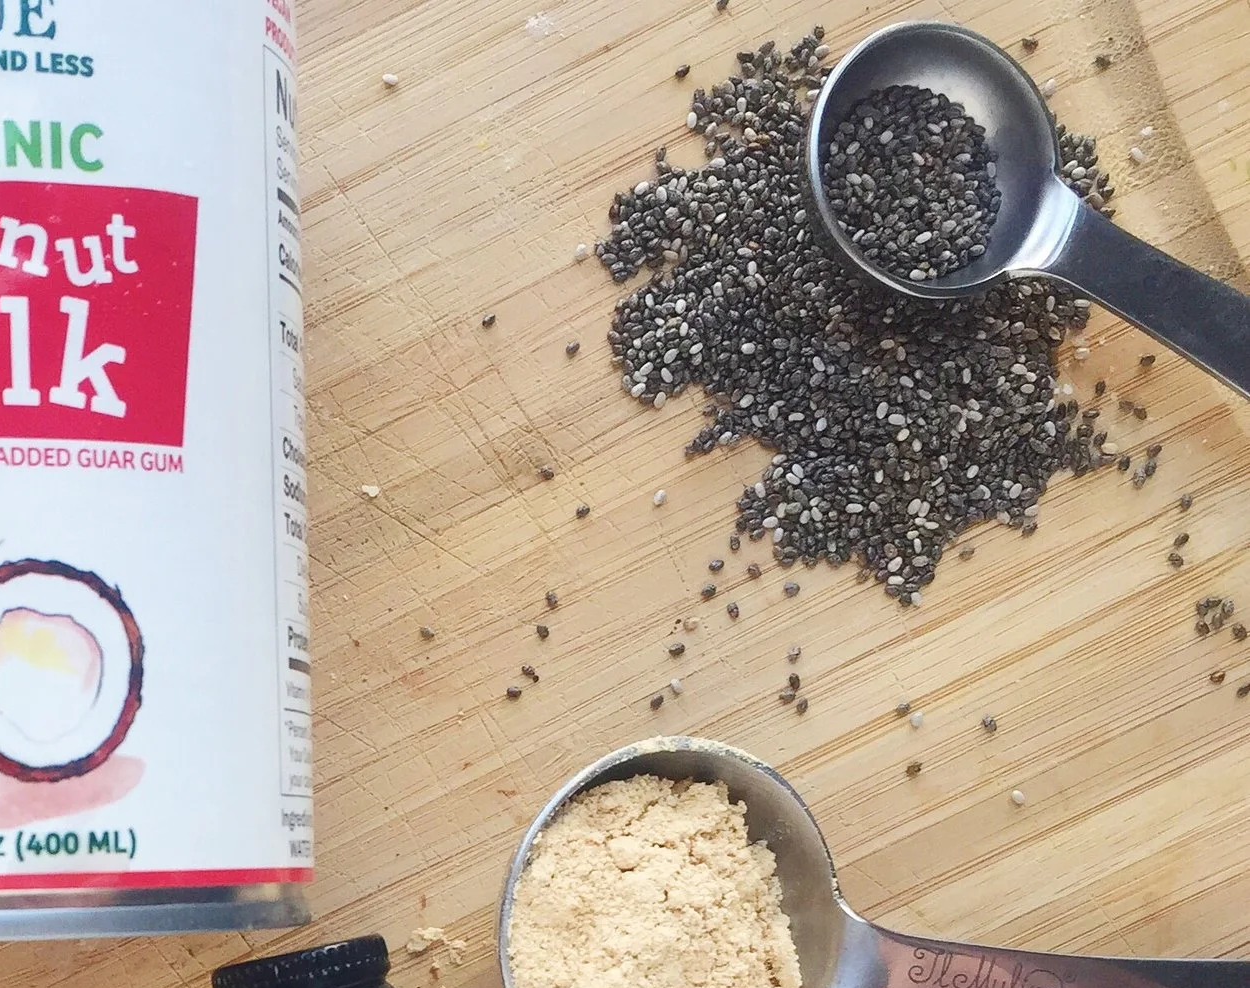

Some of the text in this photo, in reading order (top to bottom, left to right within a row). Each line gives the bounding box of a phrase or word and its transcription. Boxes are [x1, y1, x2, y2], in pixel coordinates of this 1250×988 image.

[36, 51, 94, 77] LESS
[77, 448, 136, 470] GUAR
[140, 452, 184, 473] GUM
[15, 830, 80, 861] (400
[87, 829, 137, 860] ML)
